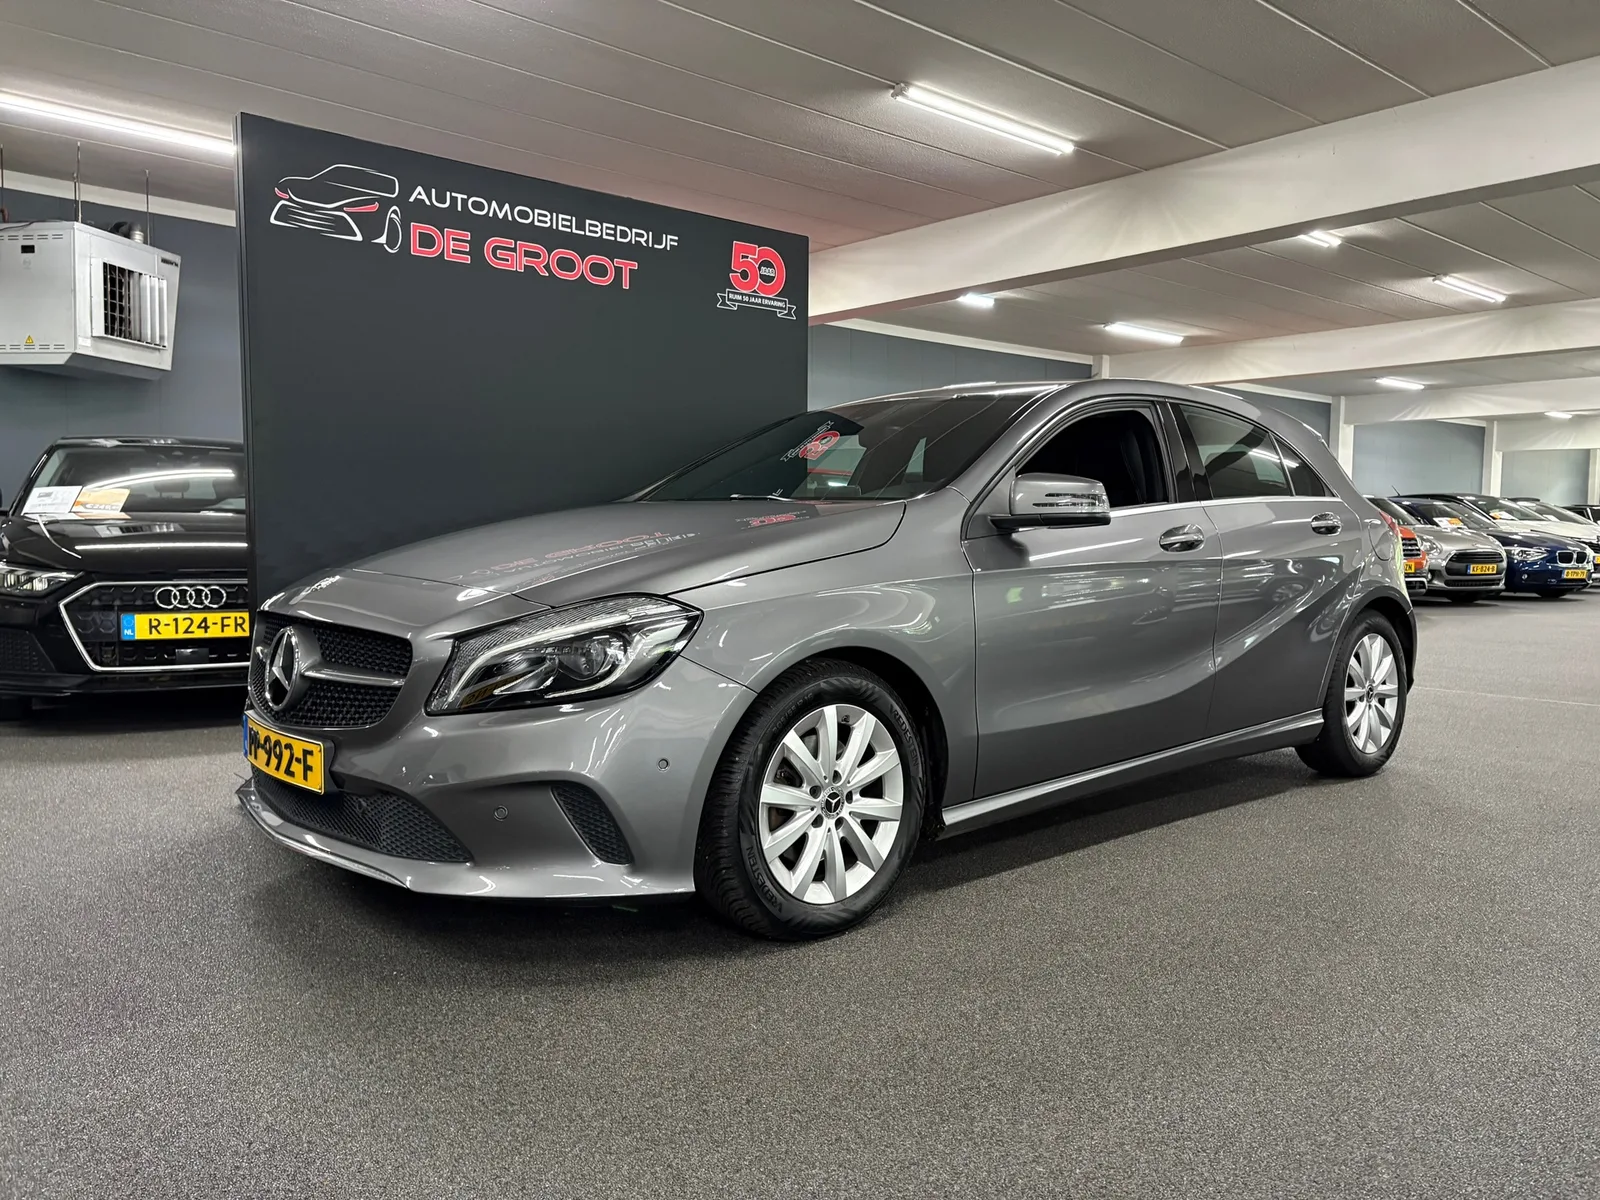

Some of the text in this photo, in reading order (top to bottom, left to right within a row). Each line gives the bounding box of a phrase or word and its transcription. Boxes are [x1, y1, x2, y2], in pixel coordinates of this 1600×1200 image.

[408, 185, 679, 251] AUTOMOBIELBEDRIJF
[410, 222, 638, 289] DE GROOT
[729, 240, 786, 297] 50
[729, 293, 742, 301] RUIM
[749, 296, 762, 304] JAAR
[762, 298, 786, 308] ERVARING
[148, 615, 247, 636] R-124-FR
